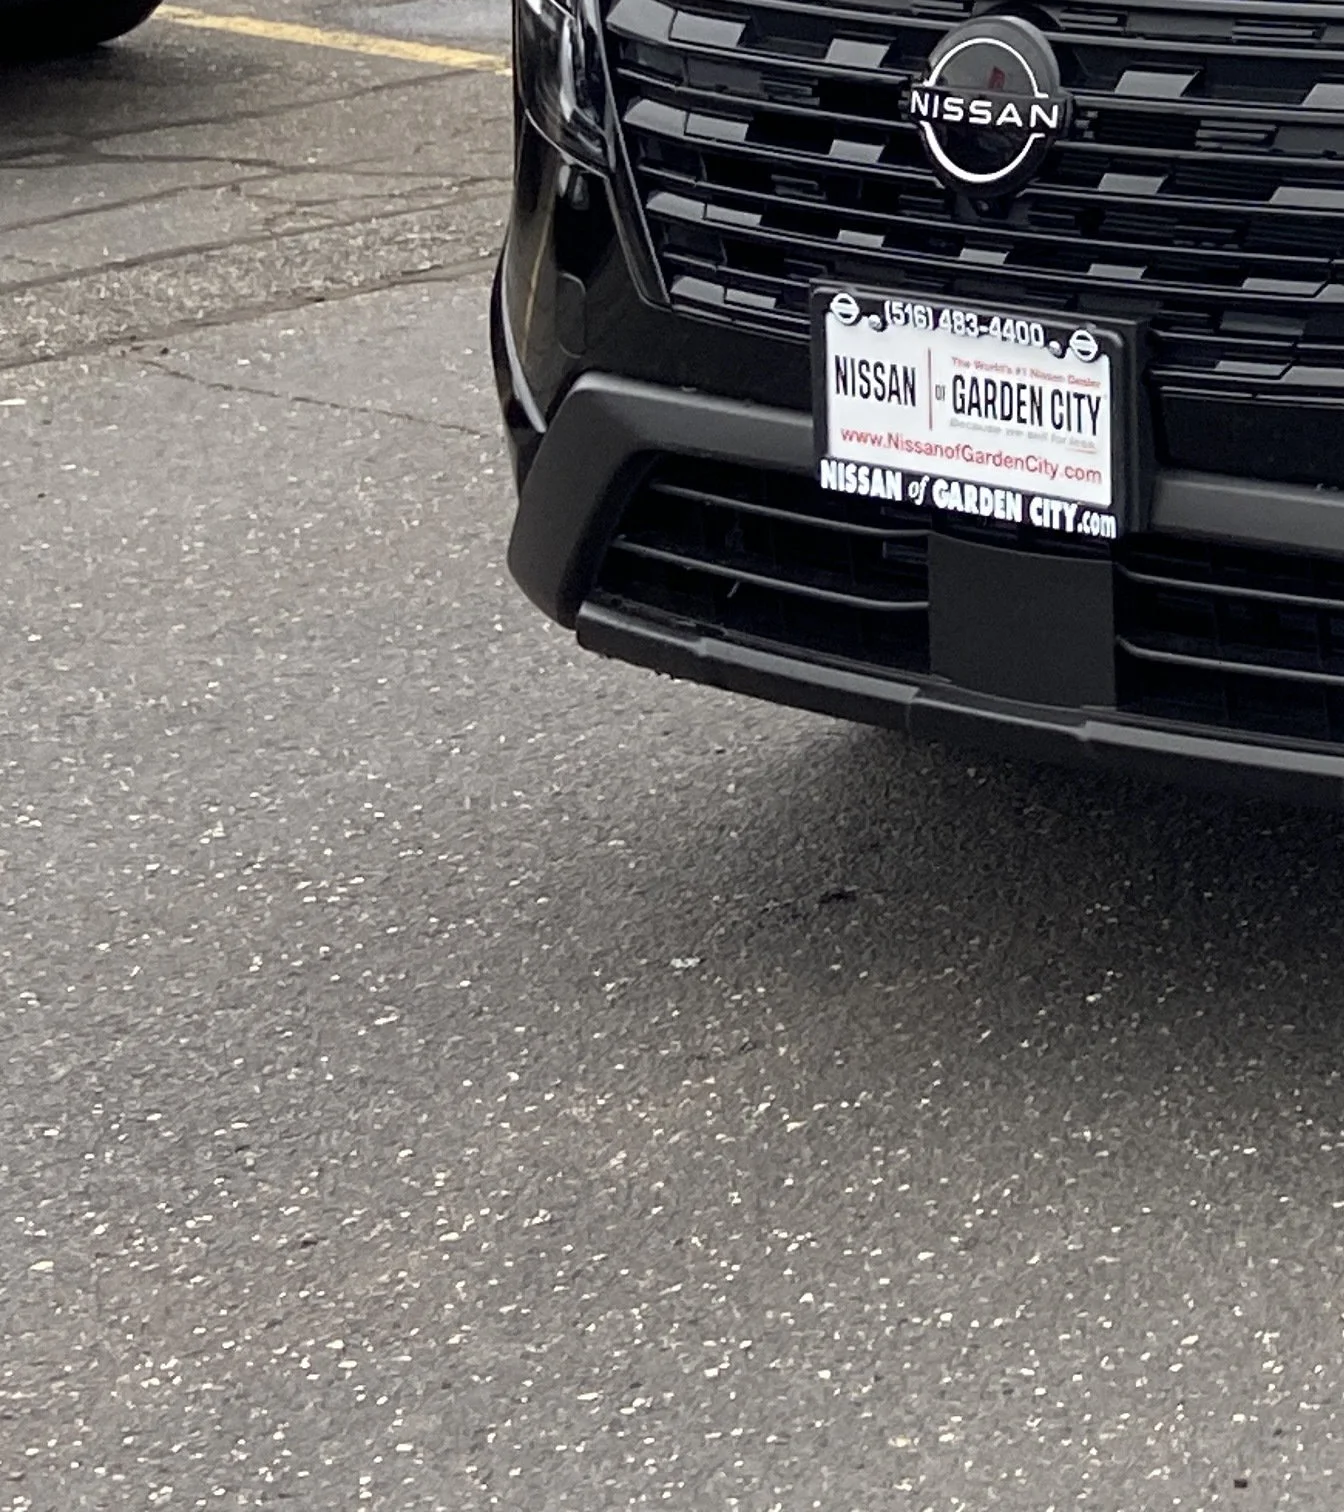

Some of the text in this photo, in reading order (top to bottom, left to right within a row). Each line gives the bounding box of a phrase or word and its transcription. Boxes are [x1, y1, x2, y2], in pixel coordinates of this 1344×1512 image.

[910, 90, 1058, 129] NISSAN
[884, 300, 1044, 348] (516) 483-4400
[834, 354, 917, 408] NISSAN
[952, 374, 1044, 428] GARDEN
[1050, 389, 1102, 437] CITY
[840, 428, 1103, 484] www.NissanofGardenCity.com
[820, 459, 1117, 539] NISSAN of GARDEN CITY.com
